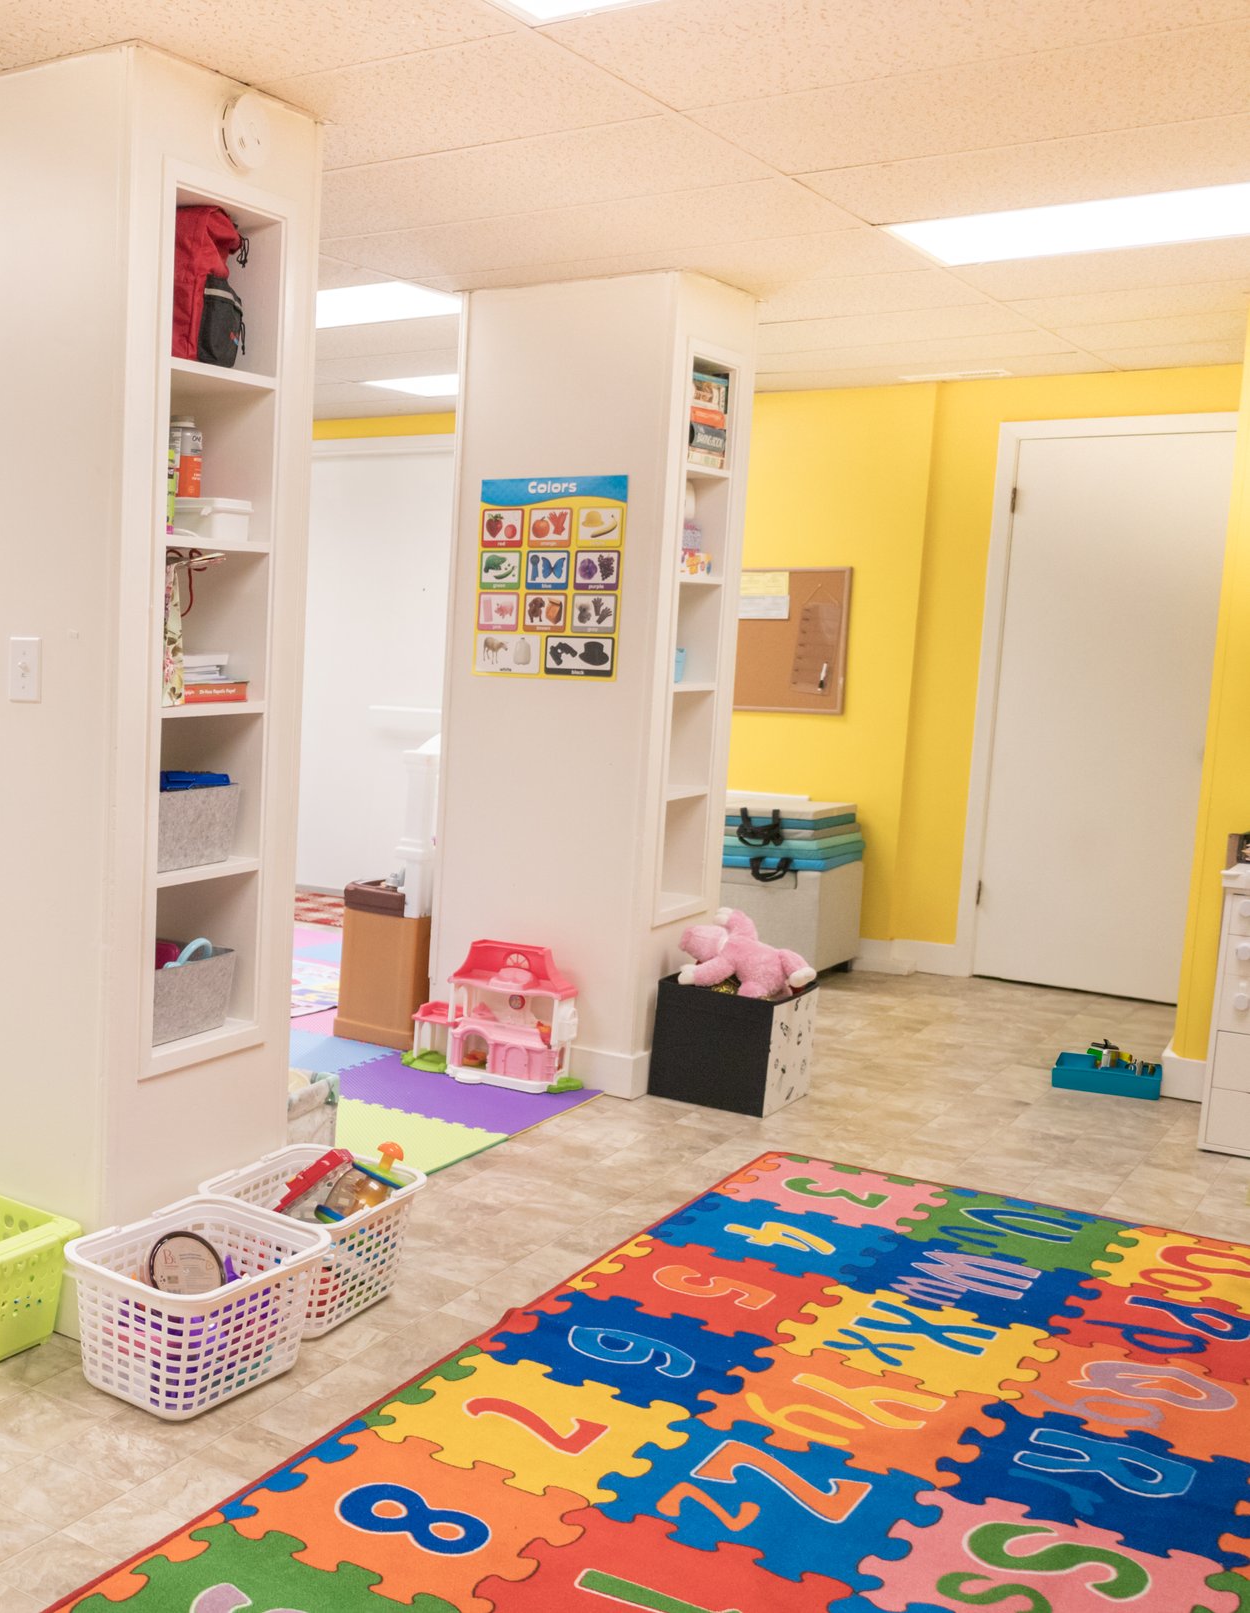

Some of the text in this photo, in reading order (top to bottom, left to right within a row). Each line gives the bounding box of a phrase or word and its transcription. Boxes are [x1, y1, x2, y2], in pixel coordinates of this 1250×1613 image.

[528, 481, 577, 494] Colors
[781, 1177, 891, 1209] 3
[724, 1221, 836, 1255] 4
[652, 1265, 776, 1310] 5
[822, 1300, 999, 1366] X x
[462, 1396, 610, 1456] 7
[792, 1373, 947, 1429] Y
[690, 1439, 873, 1523] Z
[1013, 1427, 1198, 1498] R
[334, 1481, 492, 1557] 8
[961, 1521, 1152, 1603] S
